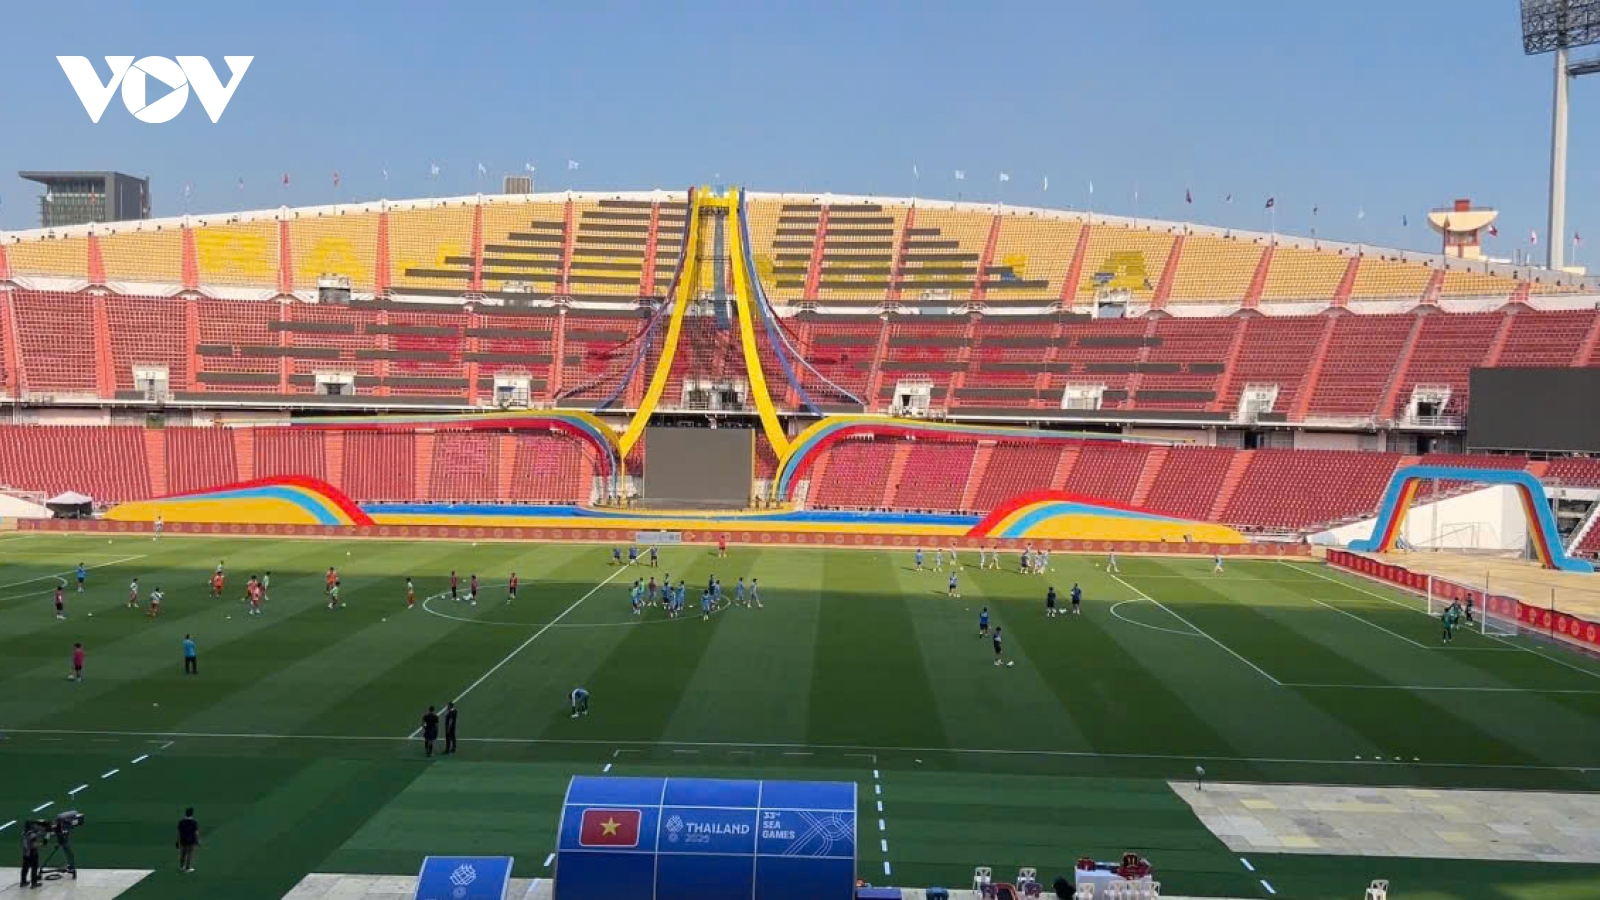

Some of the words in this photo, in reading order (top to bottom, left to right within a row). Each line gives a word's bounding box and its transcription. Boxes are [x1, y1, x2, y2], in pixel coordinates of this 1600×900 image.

[686, 823, 750, 834] THAILAND
[763, 820, 781, 829] SEA
[763, 830, 795, 839] GAMES
